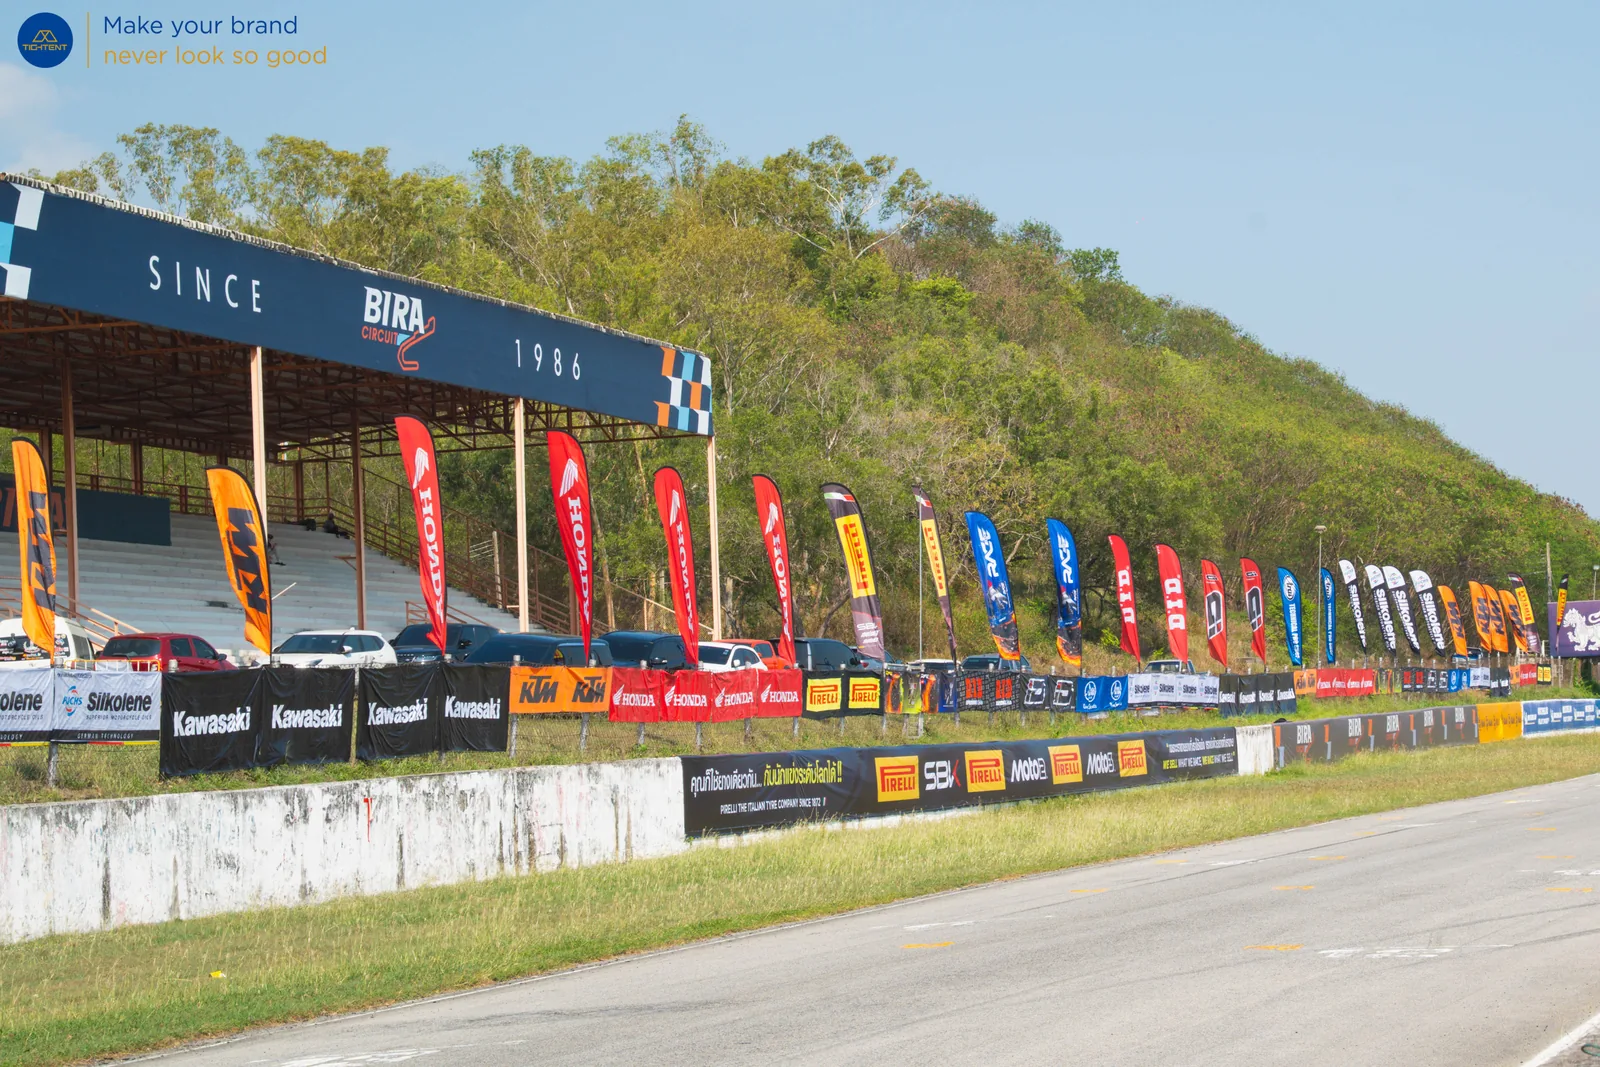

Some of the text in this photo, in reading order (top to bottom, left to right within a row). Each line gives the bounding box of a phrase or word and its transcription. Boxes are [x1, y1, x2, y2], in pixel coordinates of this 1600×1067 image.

[149, 254, 262, 313] SINCE
[363, 285, 425, 335] BIRA
[361, 325, 398, 347] CIRCUIT
[515, 338, 582, 382] 1986
[226, 507, 268, 615] KTM
[843, 522, 869, 591] PIRELLI
[87, 691, 152, 712] Silkolene
[519, 675, 558, 703] KTM
[622, 692, 655, 707] HONDA
[673, 693, 707, 708] HONDA
[724, 691, 754, 707] HONDA
[769, 690, 799, 704] HONDA
[809, 684, 839, 706] PIRELLI
[271, 703, 343, 729] Kawasaki
[444, 695, 500, 720] Kawasaki
[173, 706, 251, 737] Kawasaki
[1297, 724, 1312, 744] BIRA
[1348, 718, 1362, 737] BIRA
[1386, 714, 1400, 732] BIRA
[1053, 752, 1081, 777] PIRELLI
[1119, 746, 1145, 769] PIRELLI
[879, 765, 916, 793] PIRELLI
[924, 759, 961, 791] SBK
[969, 758, 1002, 784] PIRELLI
[720, 804, 737, 815] PIRELLI
[738, 803, 747, 813] THE
[747, 801, 765, 813] ITALIAN
[765, 801, 777, 810] TYRE
[778, 799, 798, 809] COMPANY
[799, 797, 811, 808] SINCE
